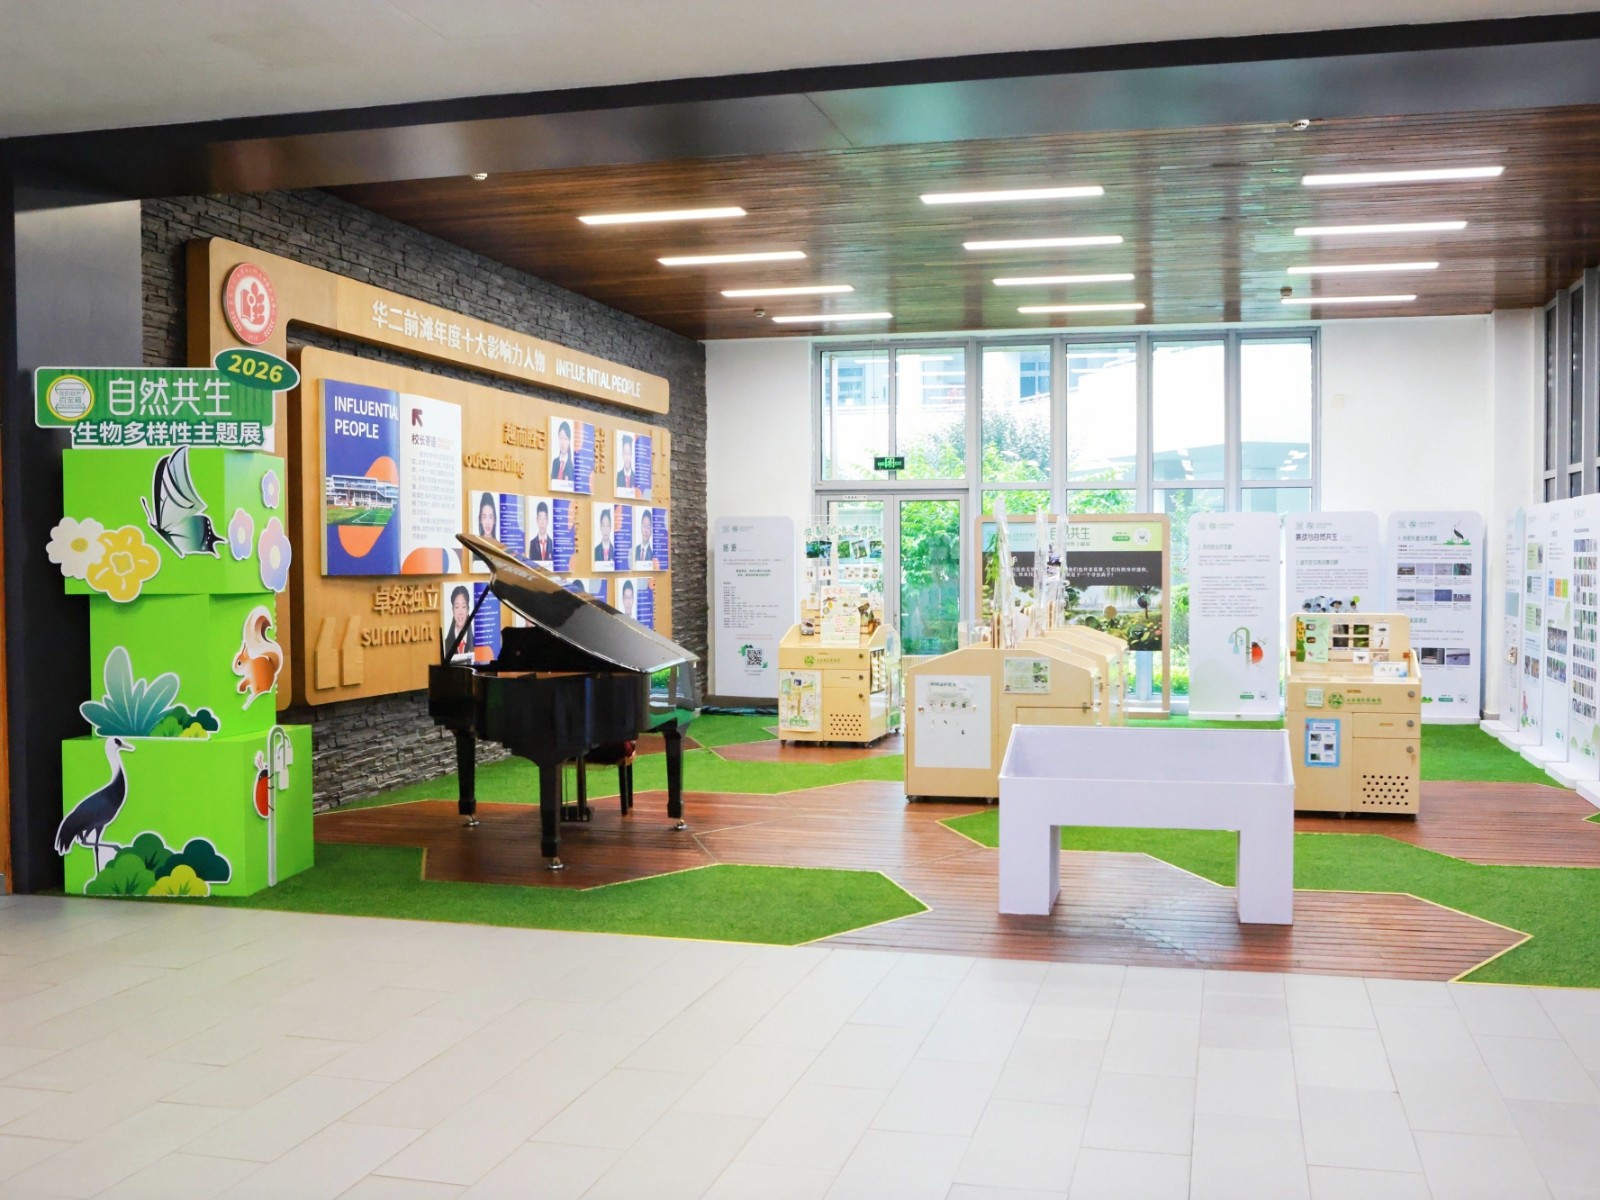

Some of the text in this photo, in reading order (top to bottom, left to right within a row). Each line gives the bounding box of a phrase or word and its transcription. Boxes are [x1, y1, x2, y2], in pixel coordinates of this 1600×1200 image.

[372, 299, 546, 374] 华二前滩年度十大影响力人物
[227, 354, 284, 384] 2026
[108, 377, 233, 417] 自然共生
[611, 374, 641, 398] PEOPLE
[74, 421, 264, 445] 生物多样性主题展
[334, 418, 380, 440] PEOPLE
[462, 454, 525, 479] outstanding
[371, 584, 440, 616] 卓然独立
[361, 621, 435, 648] surmount
